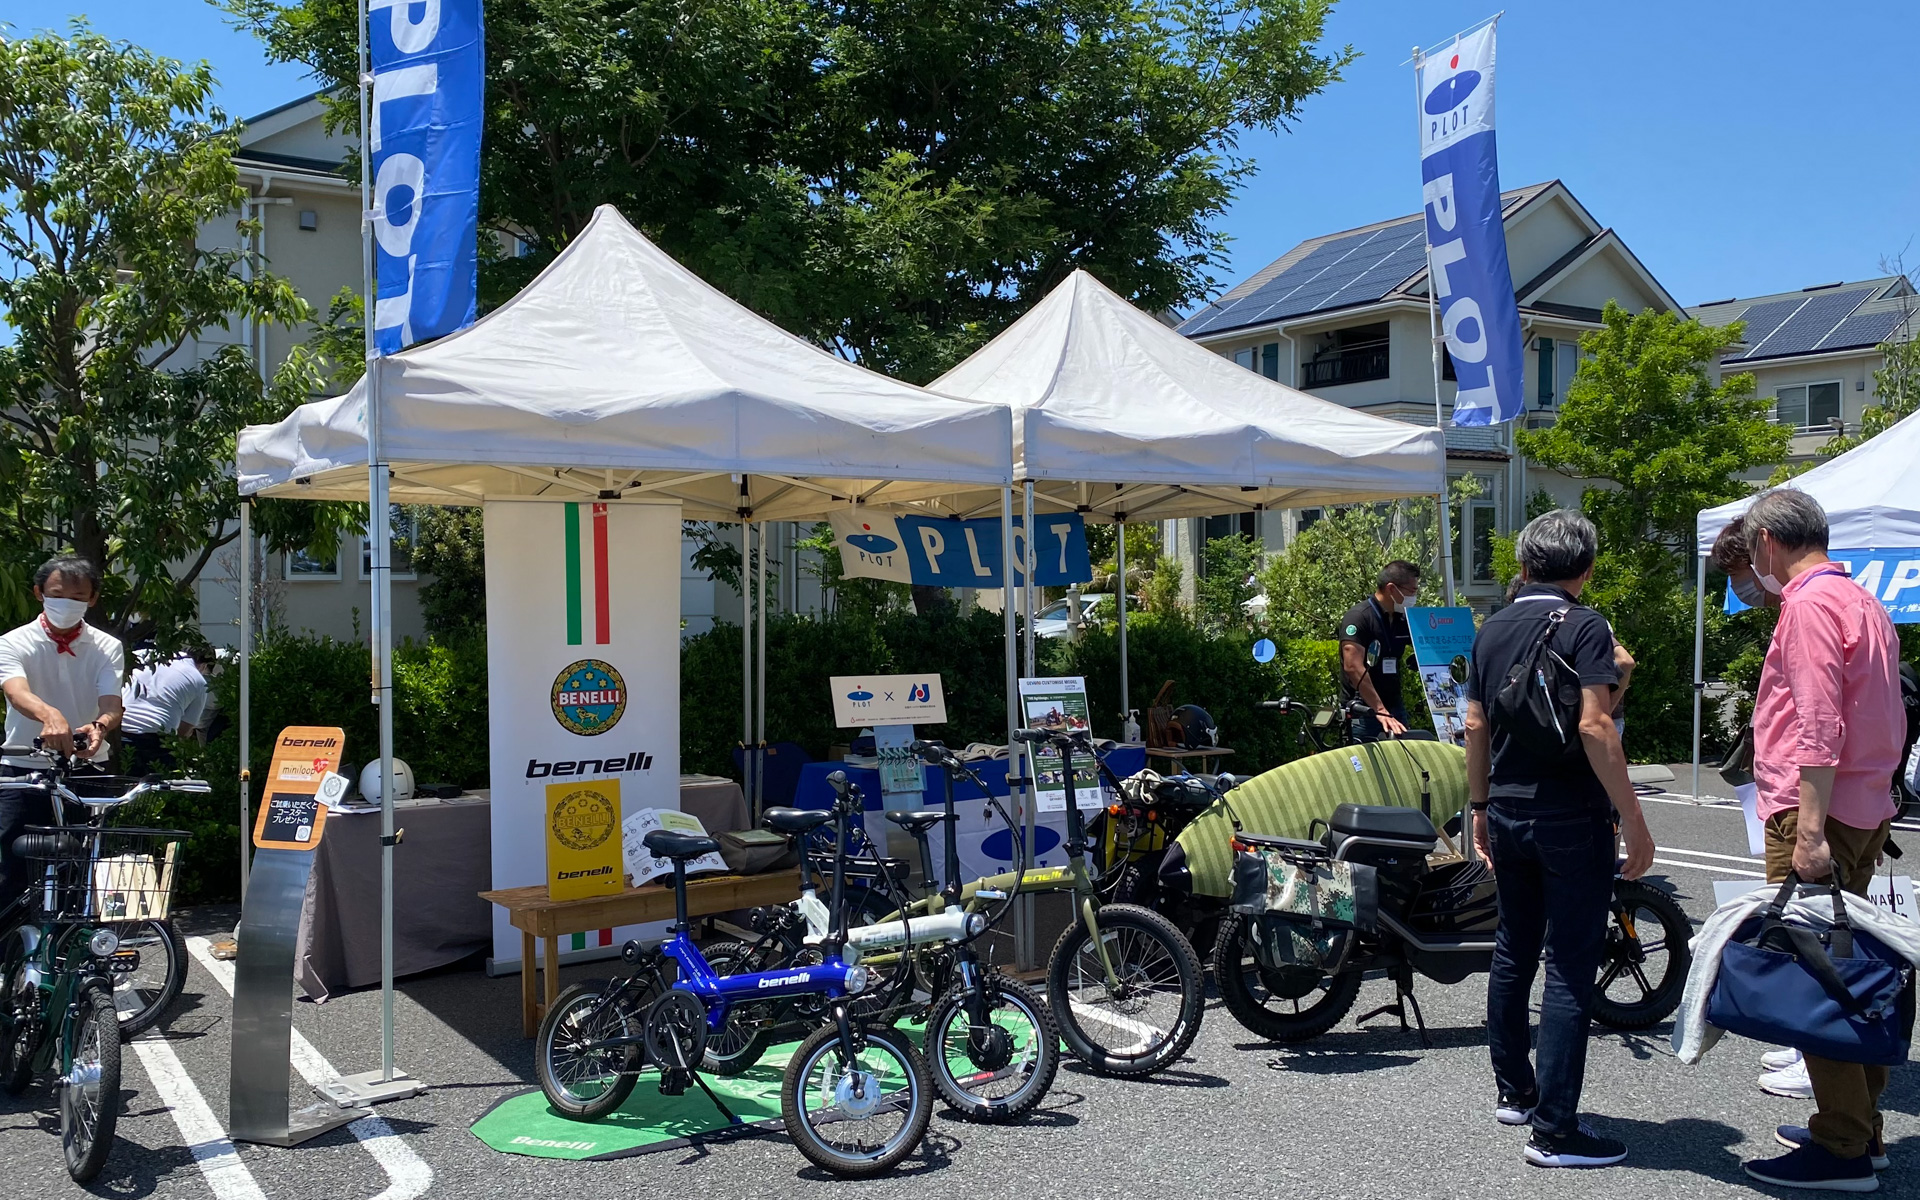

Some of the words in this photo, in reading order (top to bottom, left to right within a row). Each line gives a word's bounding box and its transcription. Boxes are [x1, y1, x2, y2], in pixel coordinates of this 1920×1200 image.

[1431, 104, 1469, 141] PLOT
[1424, 172, 1501, 426] PLOT
[859, 551, 893, 567] PLOT
[559, 690, 620, 706] BENELLI
[281, 736, 337, 748] benelli
[282, 764, 316, 776] miniloop
[525, 752, 653, 778] benelli
[272, 815, 309, 825] プレゼント中
[277, 808, 308, 817] コースター
[557, 812, 611, 829] BENELLI
[557, 865, 614, 880] benelli
[1022, 871, 1063, 884] enelli
[758, 972, 810, 989] benelli
[509, 1136, 598, 1151] Benelli
